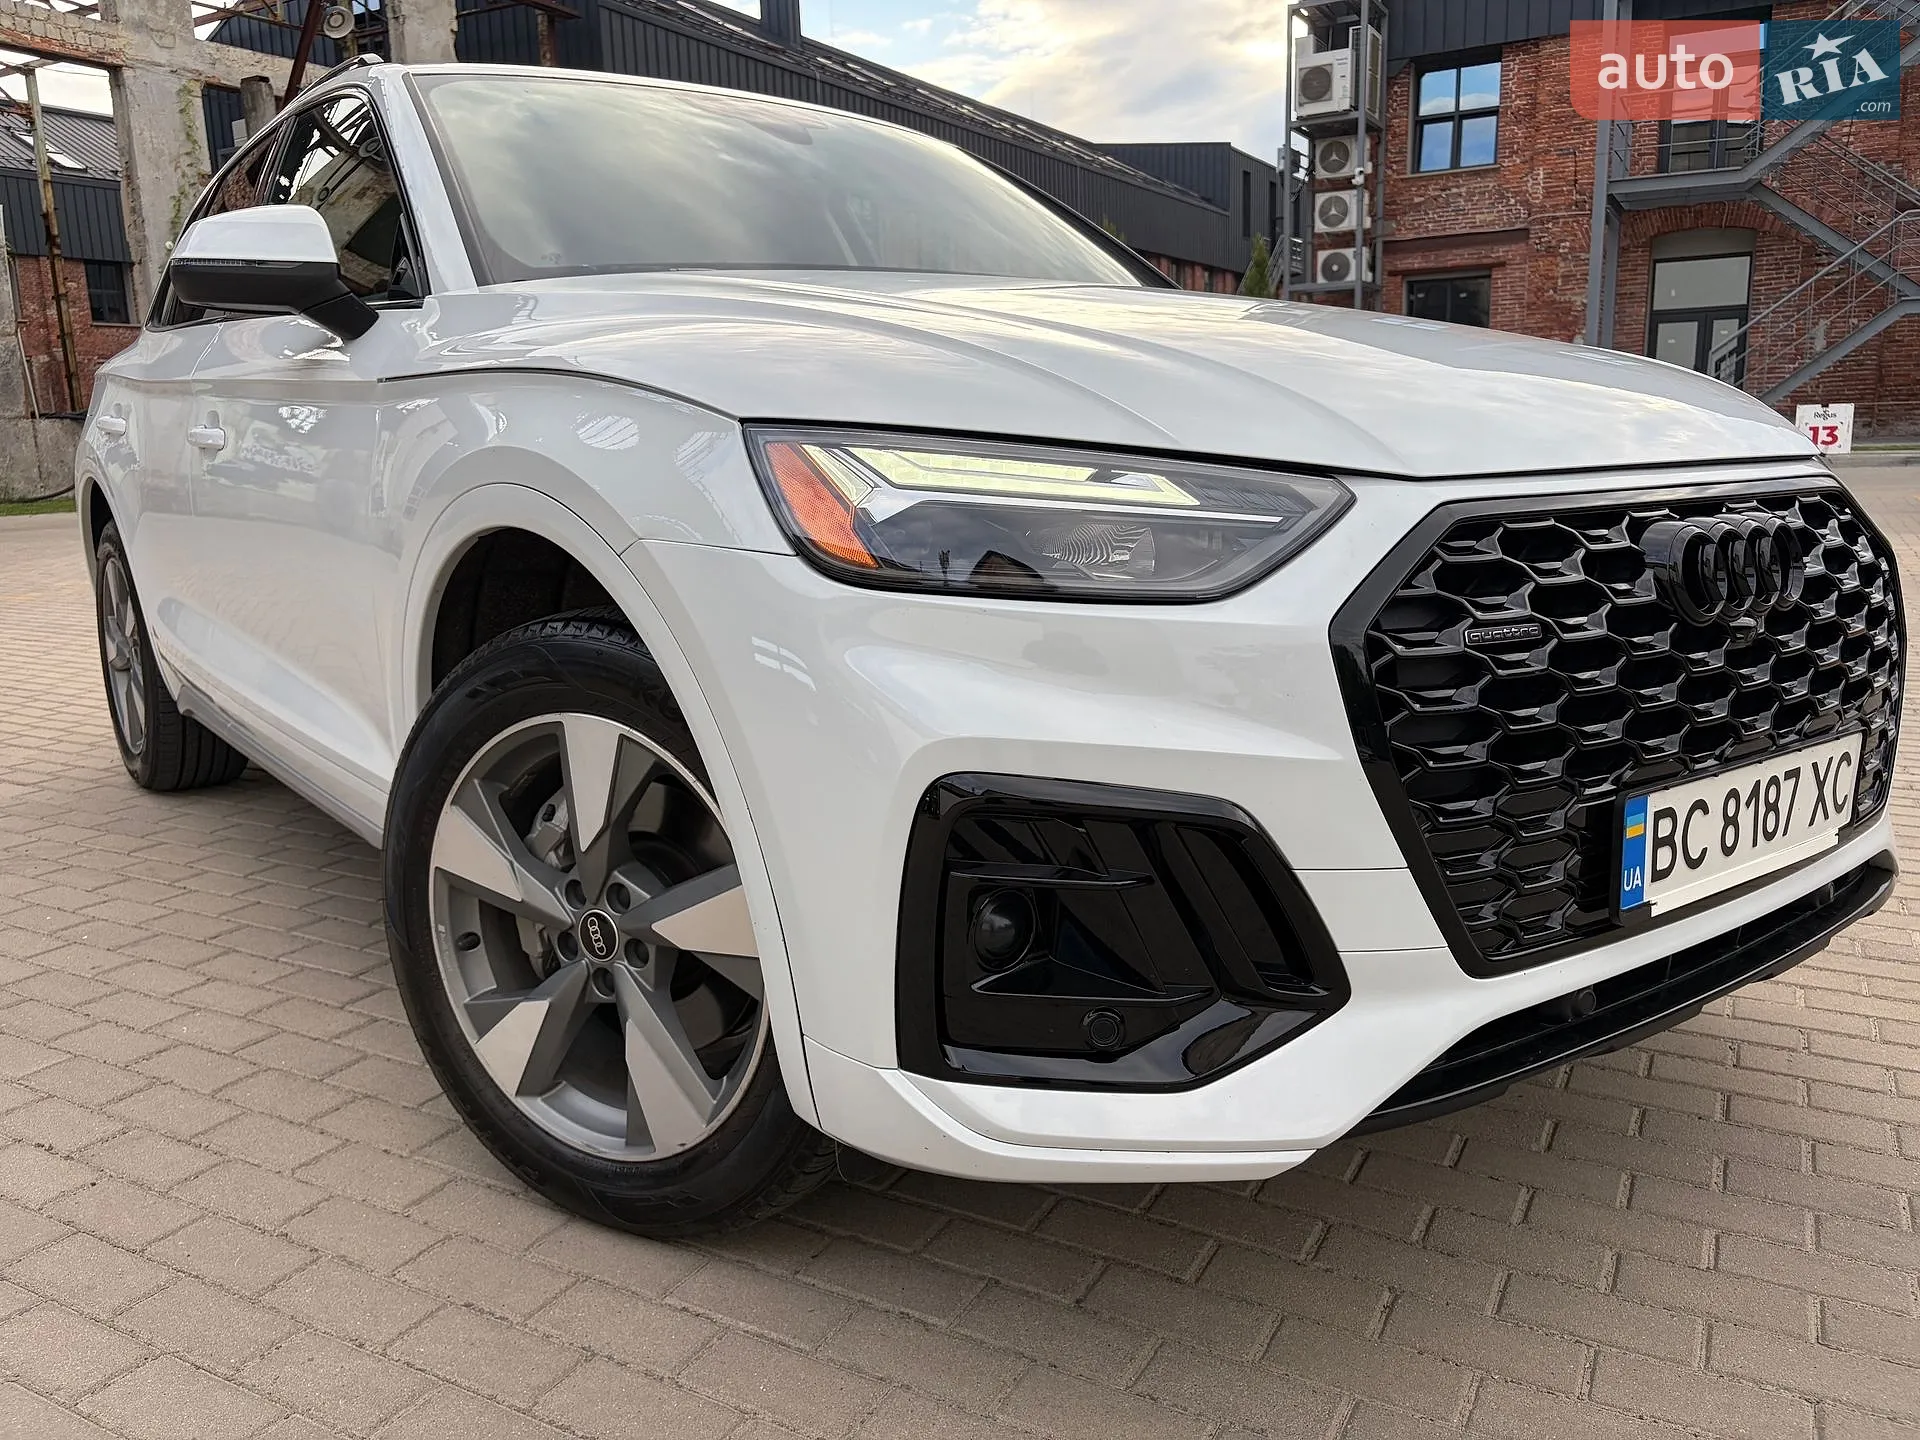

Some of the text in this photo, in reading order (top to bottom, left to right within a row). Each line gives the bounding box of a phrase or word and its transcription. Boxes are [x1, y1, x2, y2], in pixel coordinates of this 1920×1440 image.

[1808, 425, 1839, 446] 13
[1470, 627, 1539, 642] quattro
[1650, 751, 1852, 884] BC 8187 XC
[1623, 866, 1642, 891] UA
